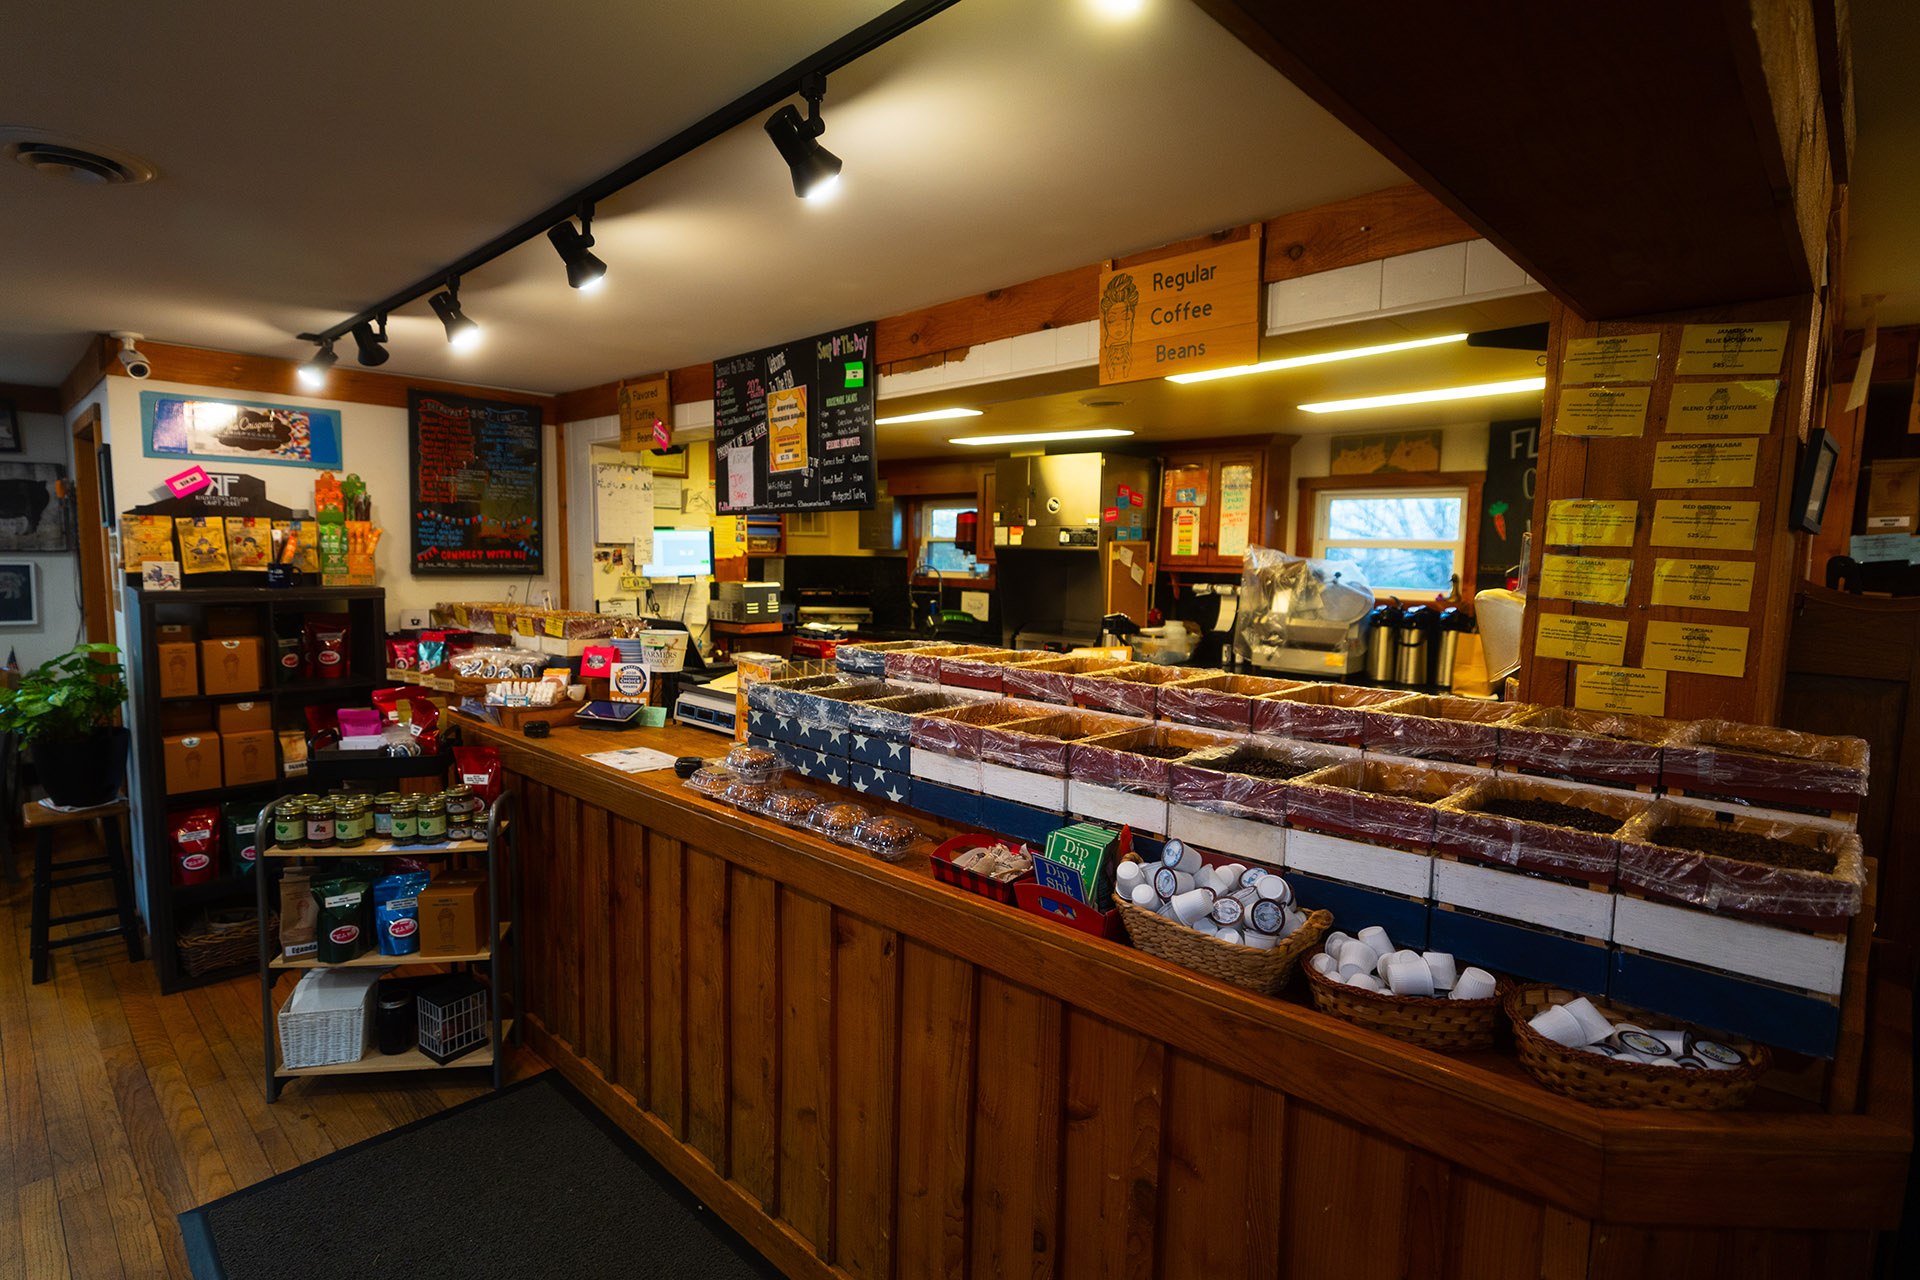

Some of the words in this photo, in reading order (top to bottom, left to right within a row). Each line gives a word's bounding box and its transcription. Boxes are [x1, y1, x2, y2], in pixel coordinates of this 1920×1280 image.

[1153, 264, 1217, 292] Regular
[1151, 302, 1212, 325] Coffee
[818, 341, 832, 362] Soup
[1156, 343, 1206, 362] Beans
[633, 389, 658, 401] Flavored
[635, 410, 654, 422] Coffee
[777, 403, 798, 412] BUFFALO
[744, 430, 754, 443] THE
[441, 550, 484, 560] CONNECT
[486, 550, 512, 560] WITH
[1063, 839, 1089, 860] Dip
[1044, 862, 1070, 882] Dip
[1060, 854, 1087, 876] Shit
[1046, 878, 1073, 897] Shit
